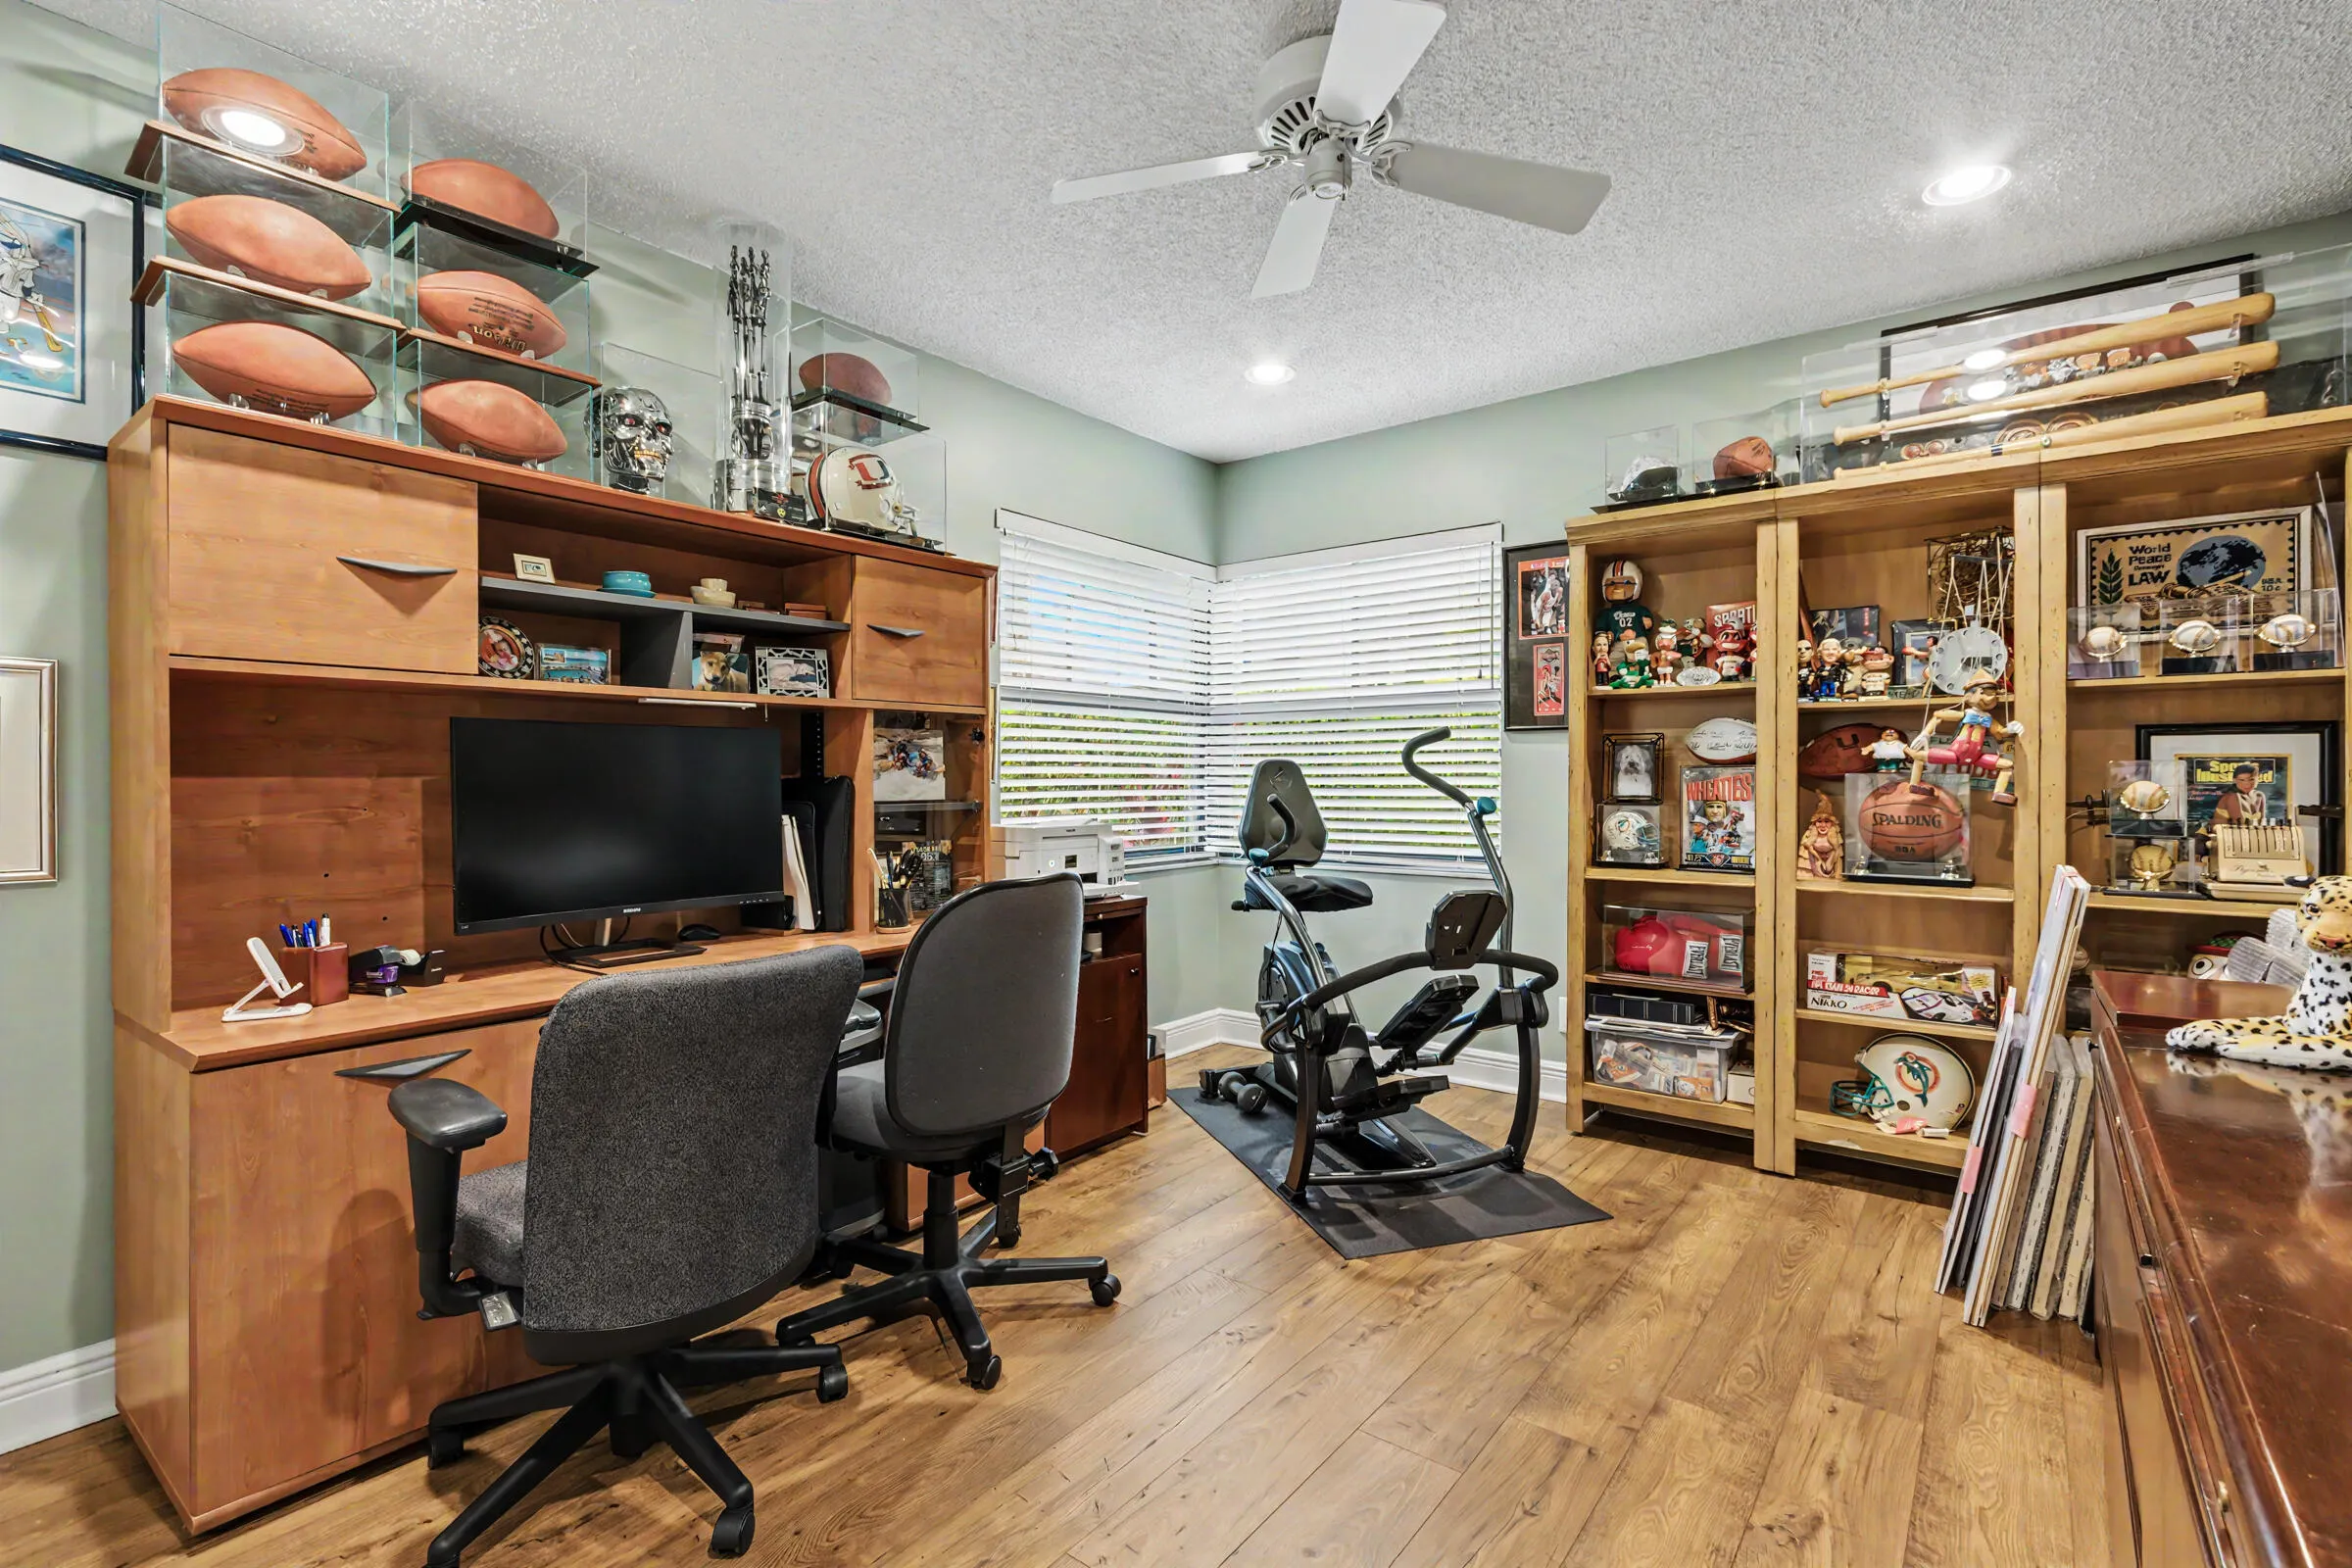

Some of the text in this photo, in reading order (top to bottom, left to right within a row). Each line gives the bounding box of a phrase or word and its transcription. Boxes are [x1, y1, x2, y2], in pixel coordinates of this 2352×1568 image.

[2129, 543, 2171, 555] World
[2129, 554, 2172, 565] Peace
[2129, 569, 2171, 586] LAW
[1686, 772, 1752, 802] WHEATIES
[1873, 812, 1942, 828] SPALDING
